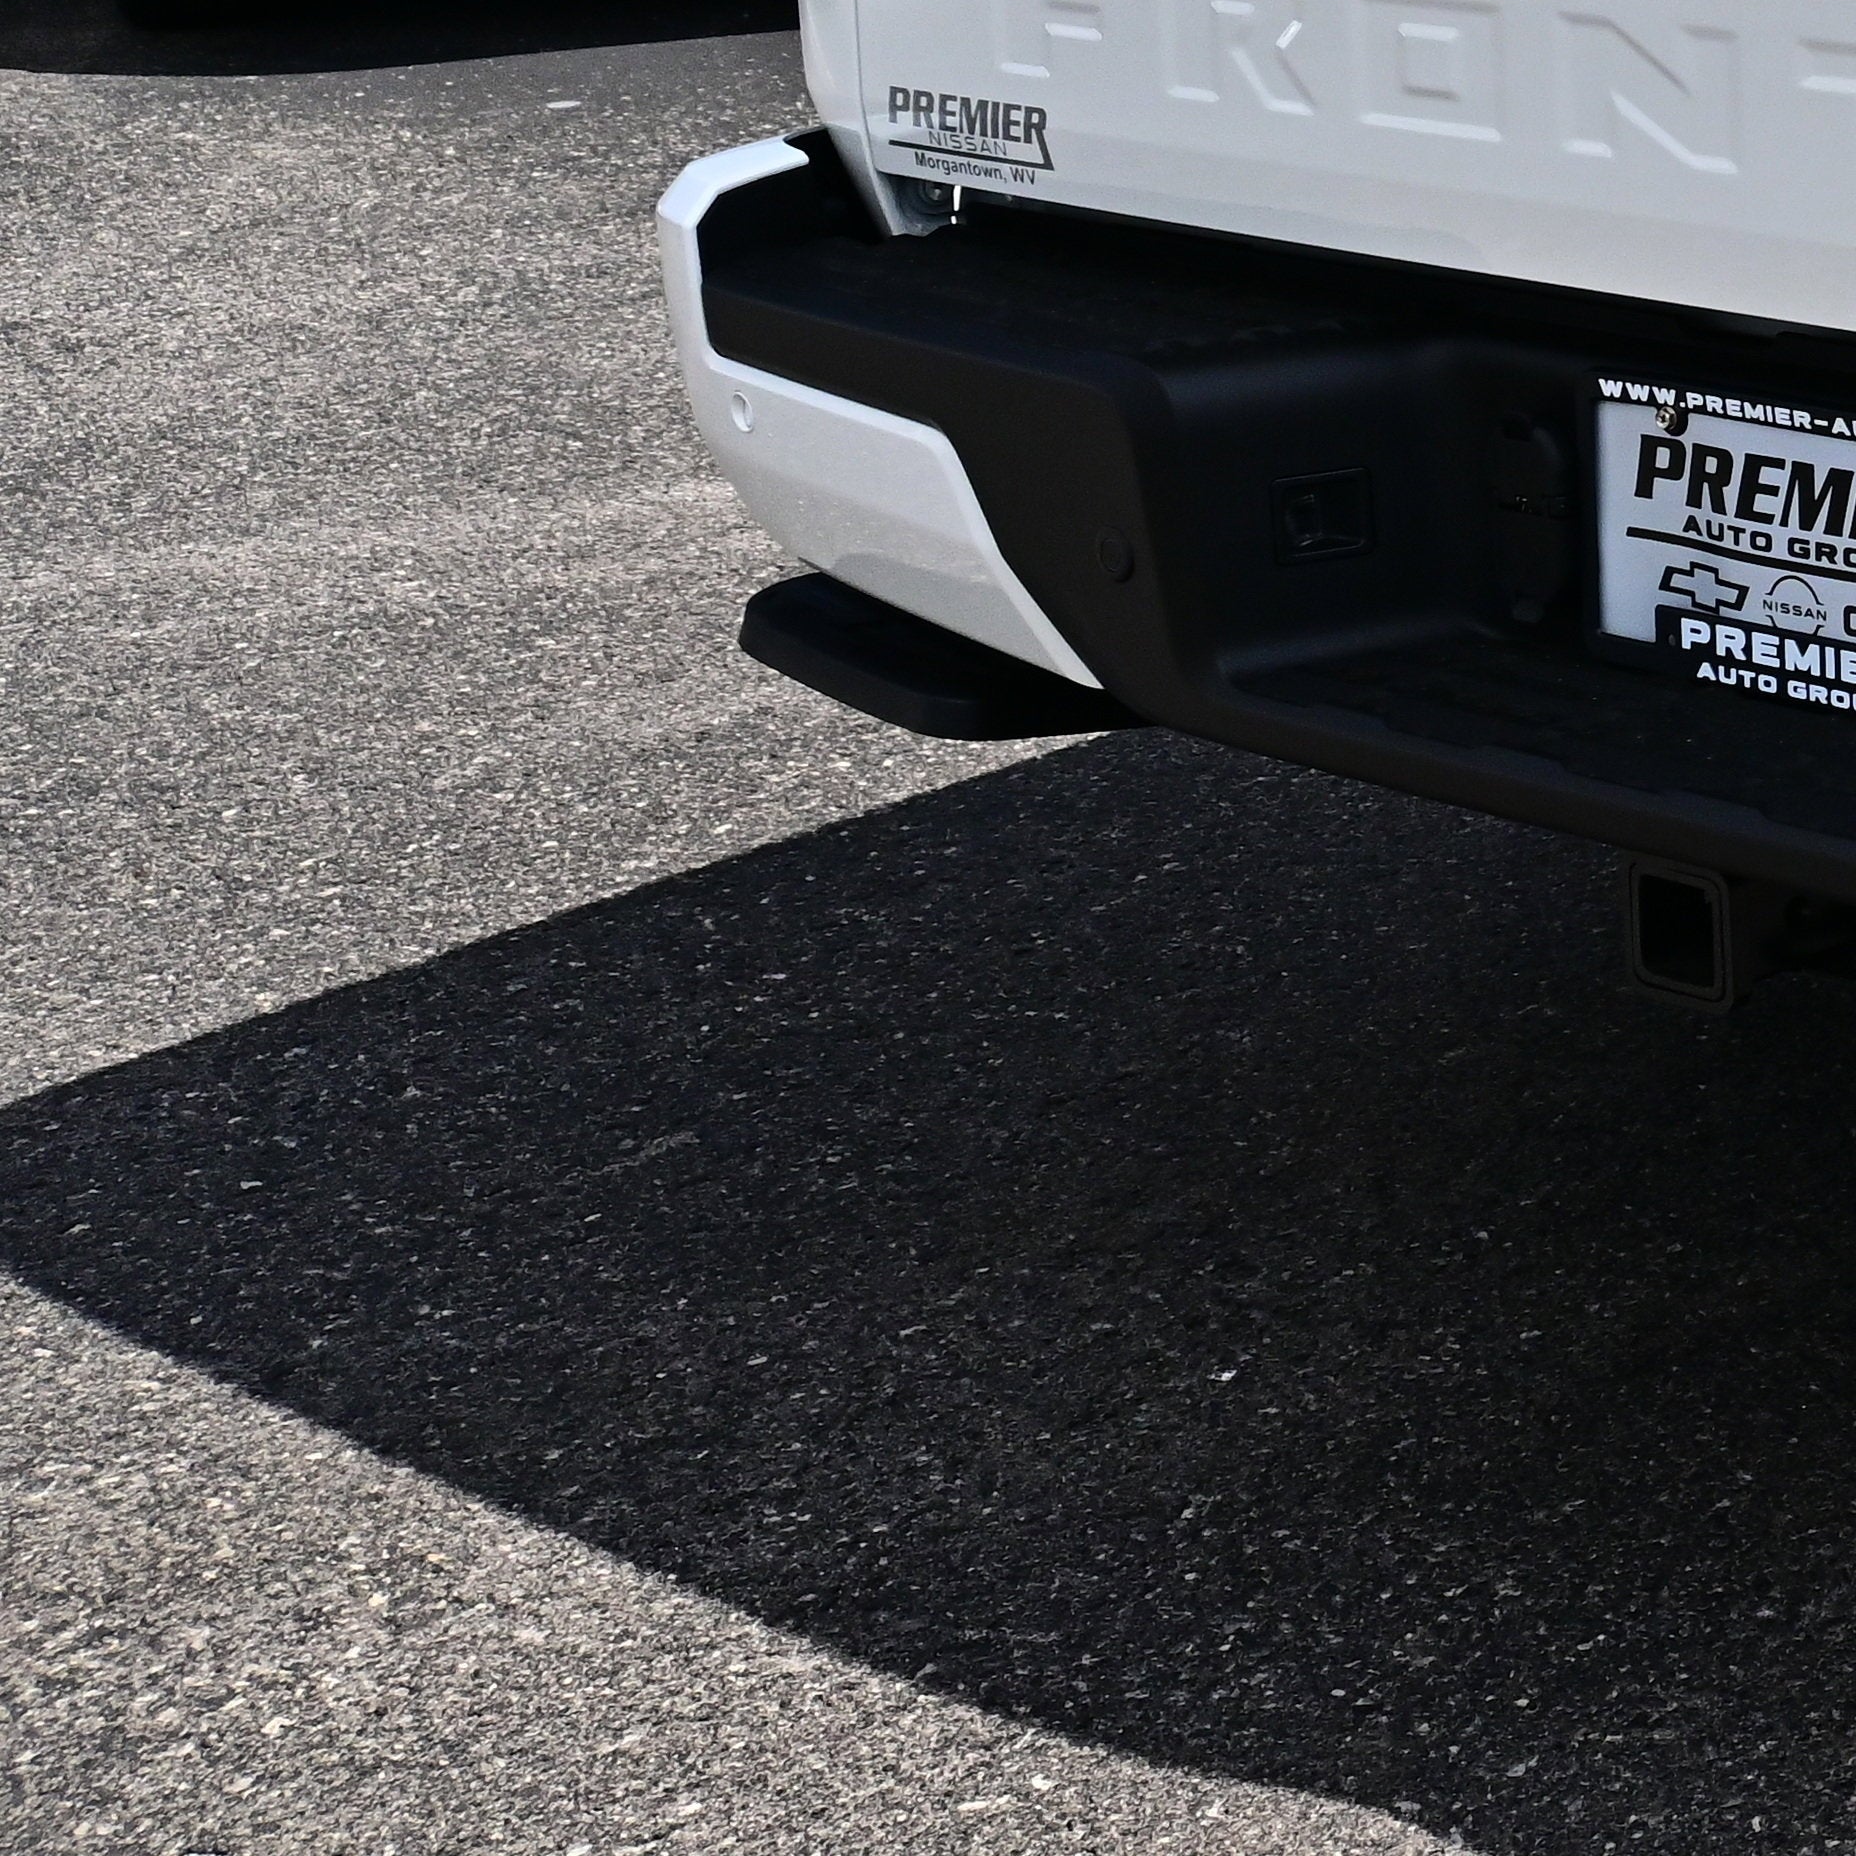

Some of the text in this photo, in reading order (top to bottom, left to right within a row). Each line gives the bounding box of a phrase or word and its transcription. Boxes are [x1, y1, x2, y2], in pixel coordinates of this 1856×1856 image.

[887, 85, 1048, 145] PREMIER
[928, 130, 1008, 157] NISSAN
[913, 150, 1037, 186] Morgantown, WV
[1682, 514, 1780, 554] AUTO
[1761, 597, 1828, 624] NISSAN
[1696, 661, 1779, 694] AUTO
